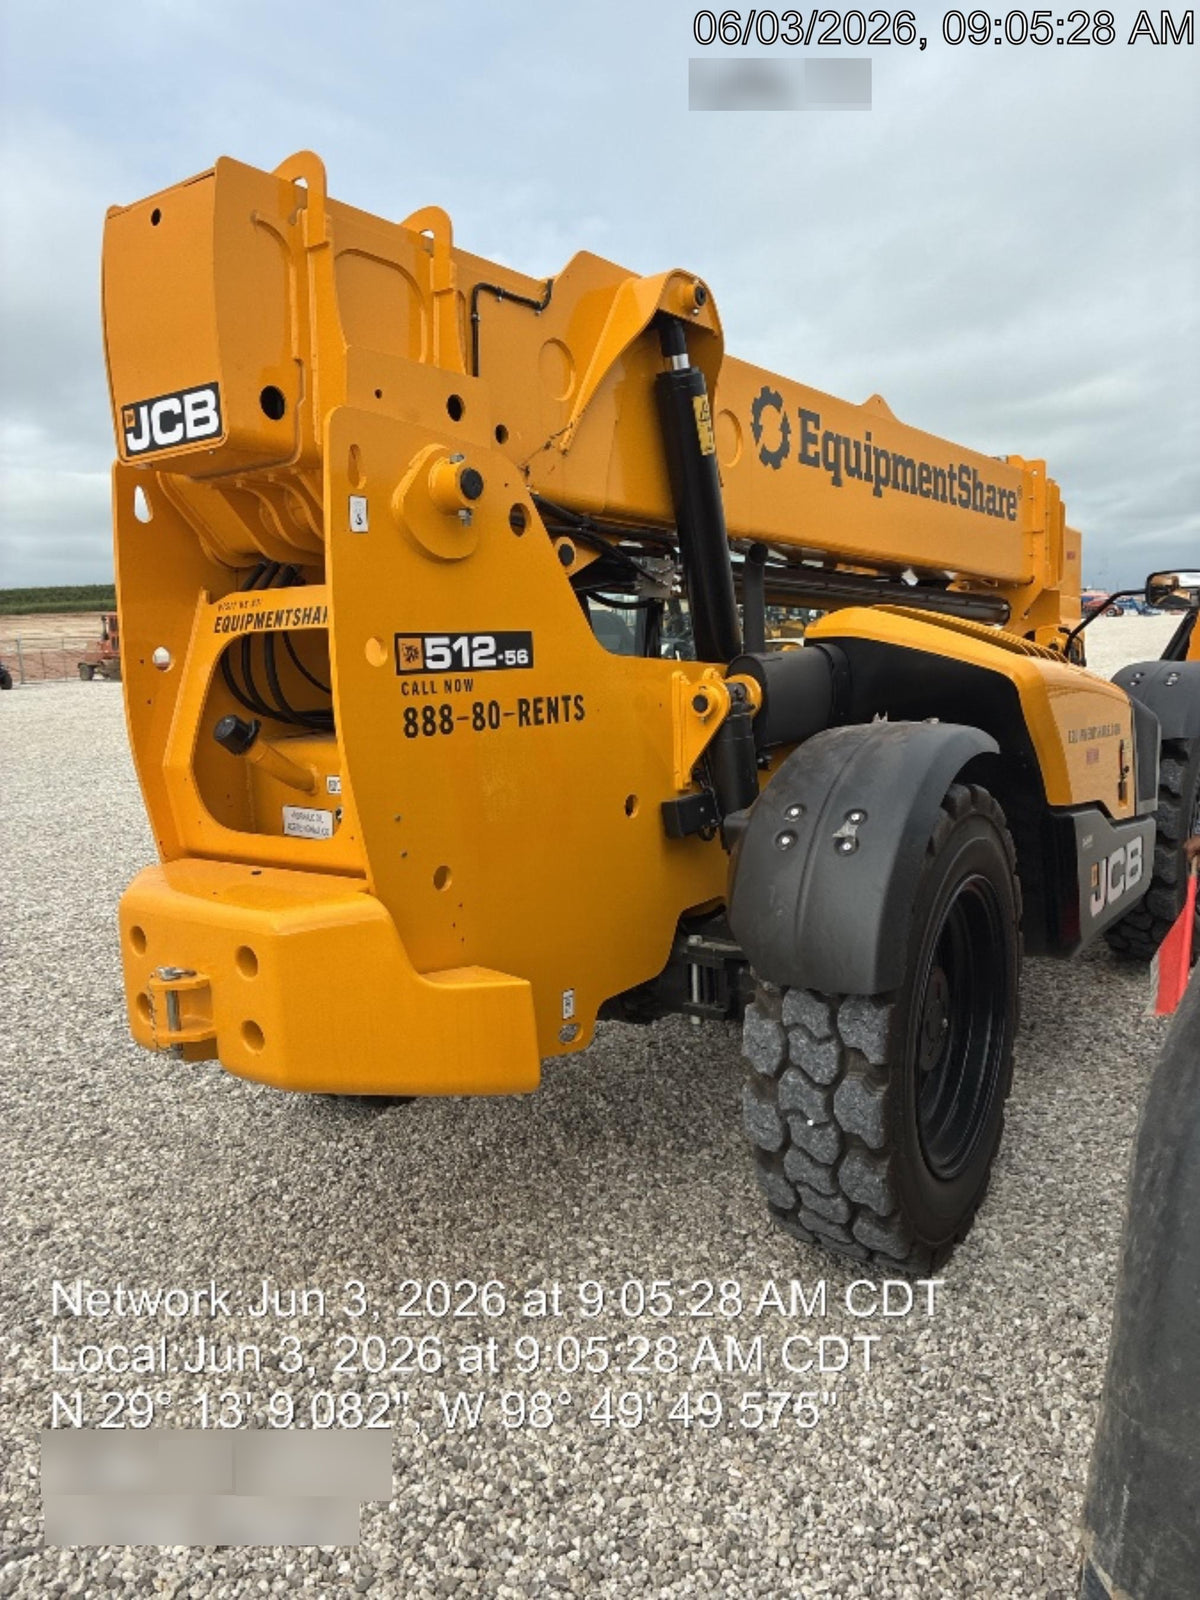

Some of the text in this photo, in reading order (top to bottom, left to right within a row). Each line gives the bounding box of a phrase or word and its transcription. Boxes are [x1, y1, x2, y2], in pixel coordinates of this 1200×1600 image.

[125, 388, 219, 451] JCB
[401, 678, 474, 696] CALL NOW
[403, 694, 586, 738] 888-80-RENTS
[1090, 836, 1143, 917] JCB
